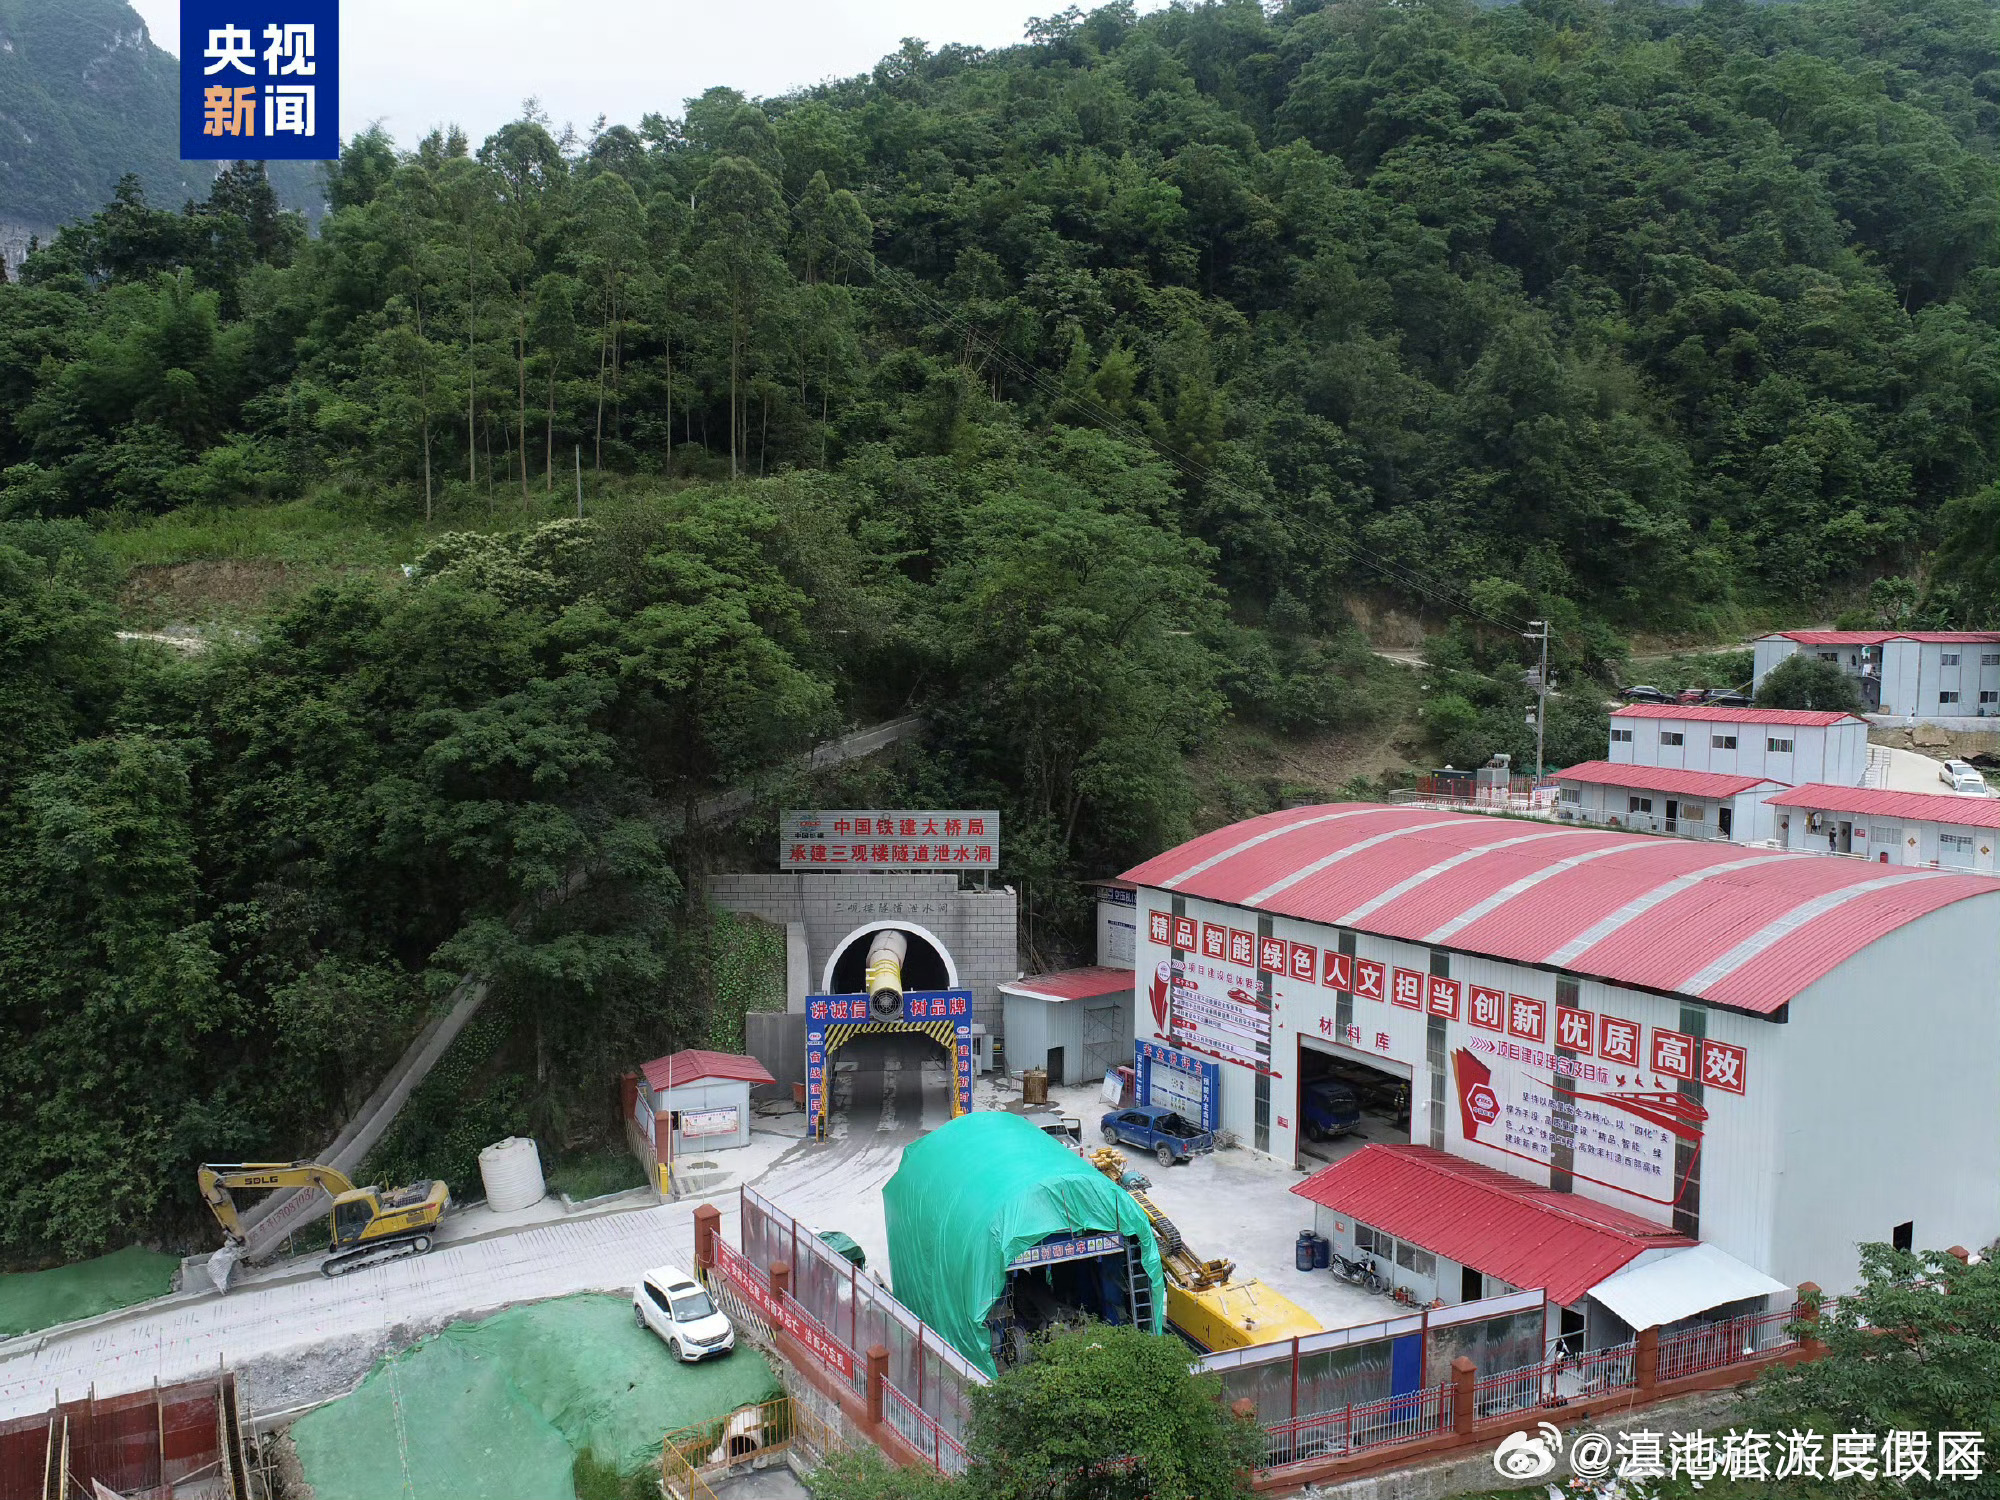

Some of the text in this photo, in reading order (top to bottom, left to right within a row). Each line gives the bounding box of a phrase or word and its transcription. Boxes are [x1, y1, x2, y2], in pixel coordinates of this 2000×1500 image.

[834, 817, 984, 836] 中国铁建大桥局
[810, 997, 967, 1019] 讲诚信 树品牌
[1319, 1016, 1390, 1051] 材料库
[1497, 1041, 1610, 1085] 项目建设理念及目标
[244, 1175, 279, 1185] SDLG
